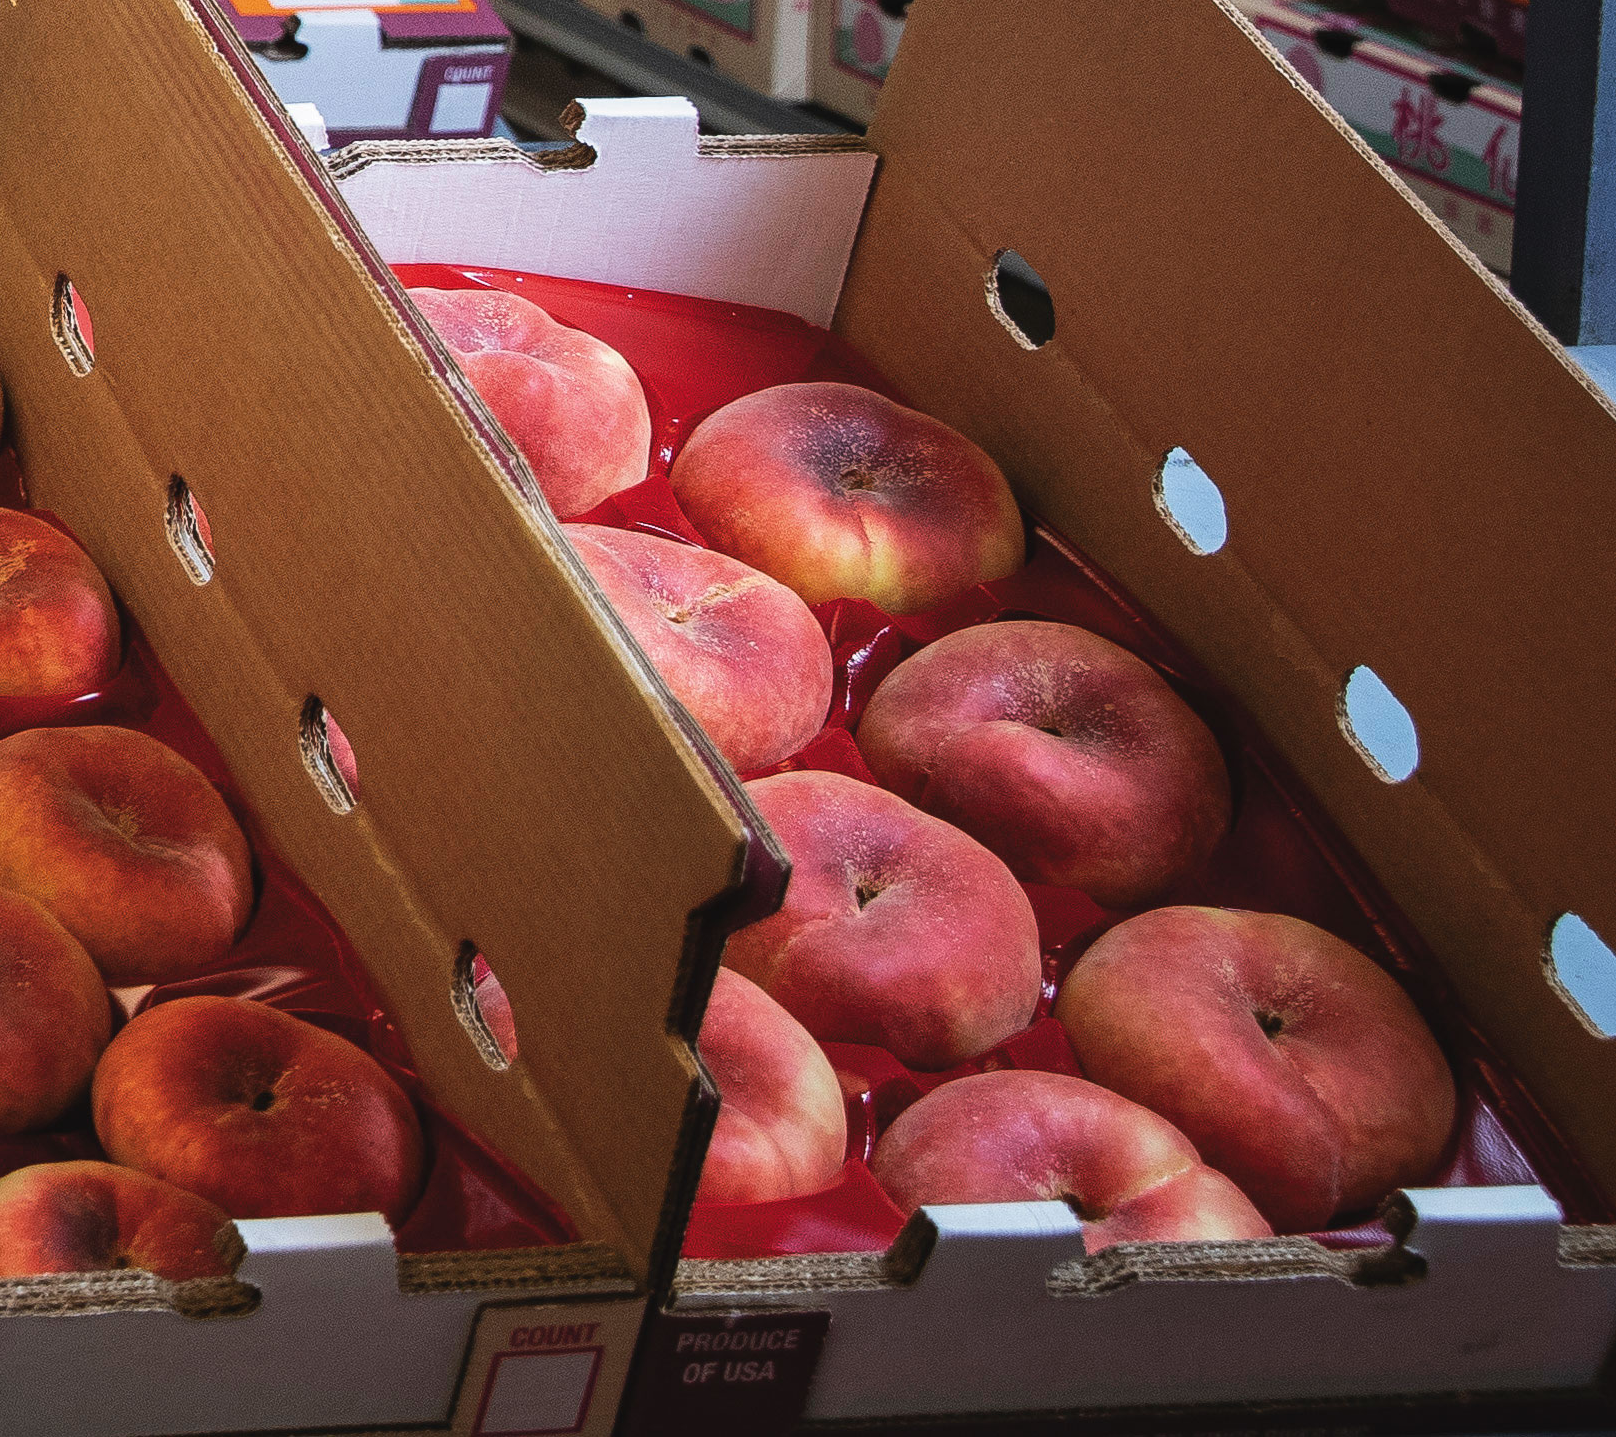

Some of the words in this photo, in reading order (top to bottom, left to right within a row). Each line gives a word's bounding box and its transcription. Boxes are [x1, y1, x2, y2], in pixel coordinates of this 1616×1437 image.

[509, 1323, 601, 1347] COUNT
[675, 1329, 799, 1354] PRODUCE
[682, 1361, 718, 1384] OF
[722, 1360, 776, 1383] USA
